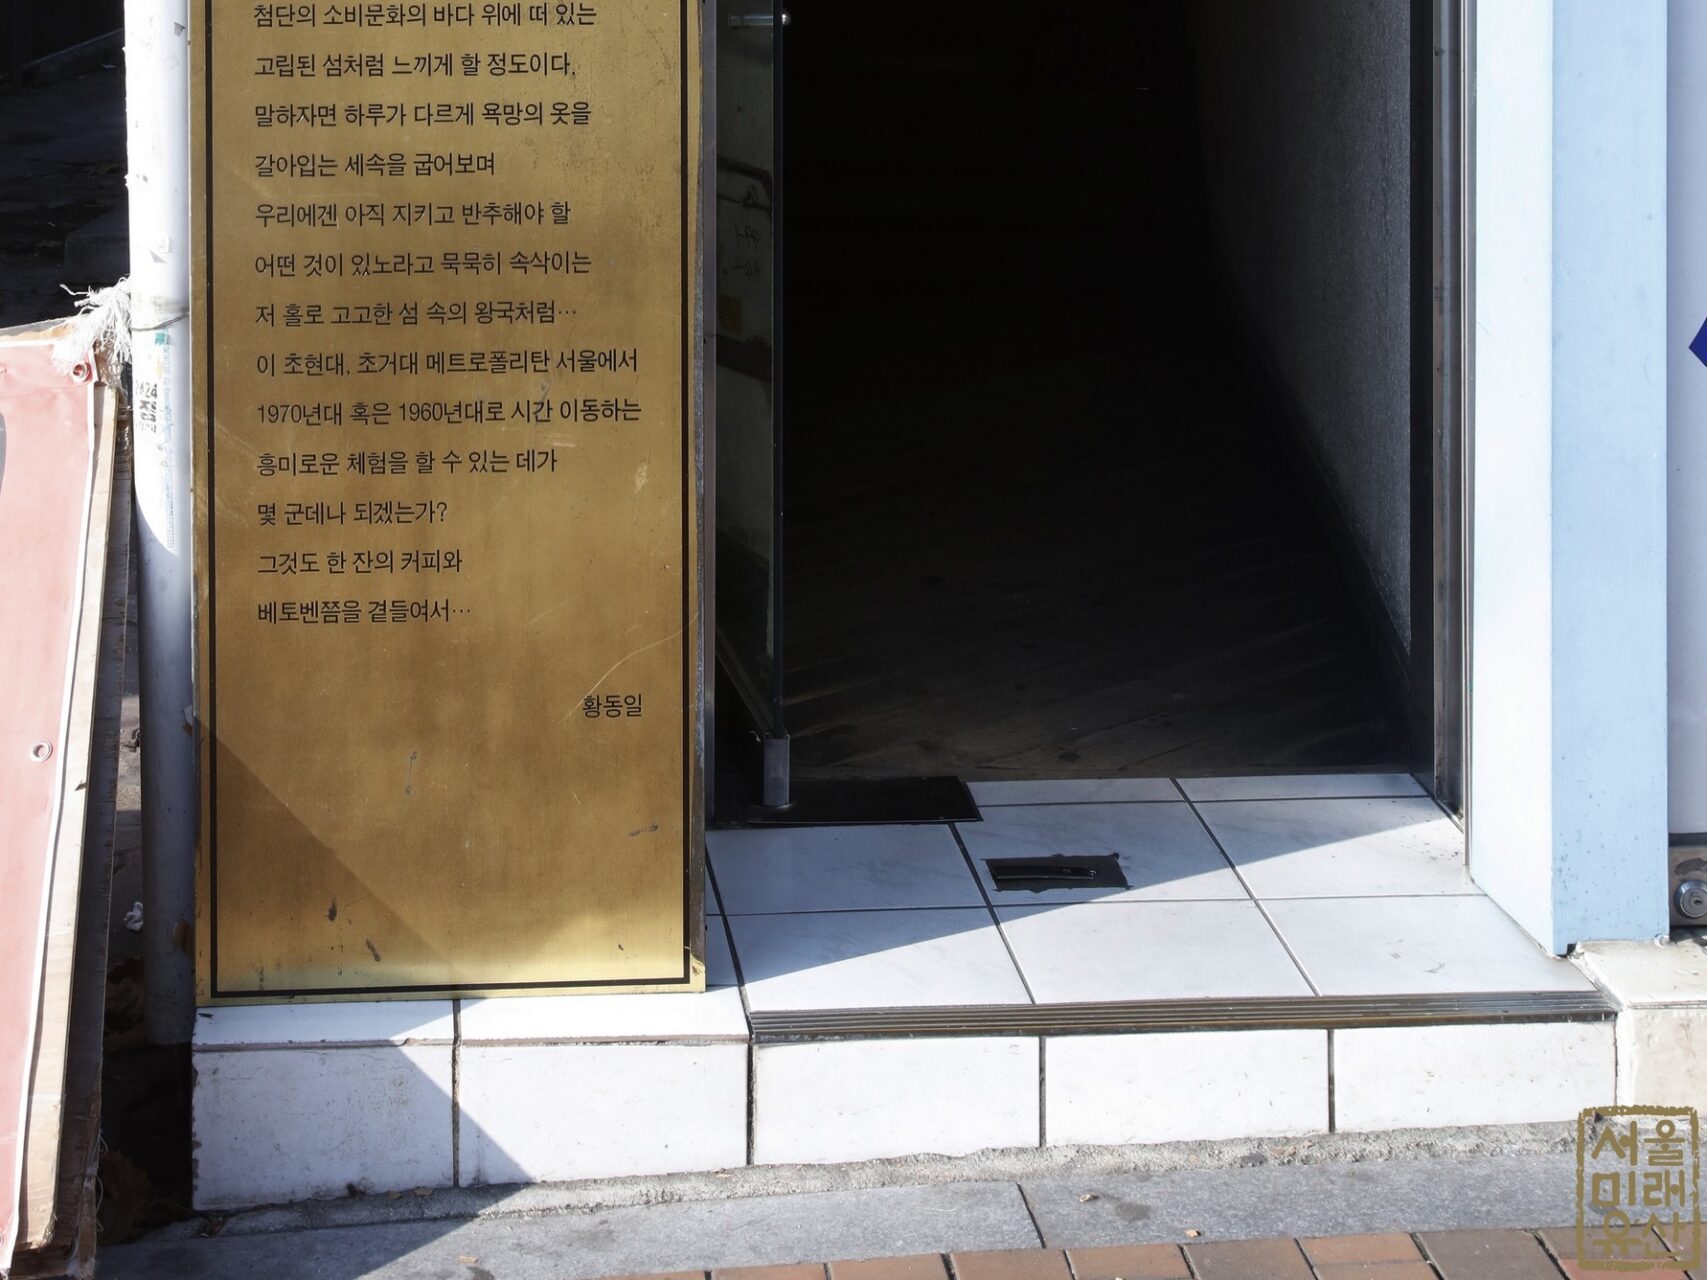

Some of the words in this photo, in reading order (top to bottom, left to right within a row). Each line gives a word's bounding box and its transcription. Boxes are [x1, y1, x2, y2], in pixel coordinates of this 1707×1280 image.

[253, 3, 316, 28] 첨단의
[322, 2, 426, 28] 소비문화의
[433, 2, 475, 27] 바다
[481, 2, 521, 27] 위에
[529, 1, 548, 27] 떠
[555, 1, 598, 26] 있는
[254, 53, 316, 78] 고립된
[322, 52, 384, 78] 섬처럼
[391, 52, 453, 78] 느끼게
[460, 52, 482, 77] 할
[487, 51, 576, 77] 정도이다.
[255, 103, 337, 128] 말하자면
[344, 103, 407, 127] 하루가
[414, 102, 474, 127] 다르게
[481, 101, 543, 127] 욕망의
[549, 101, 592, 126] 옷을
[255, 153, 339, 178] 갈아입는
[344, 152, 407, 177] 세속을
[412, 151, 495, 177] 굽어보며
[255, 203, 338, 228] 우리에겐
[345, 202, 385, 227] 아직
[392, 202, 455, 227] 지키고
[462, 201, 545, 226] 반추해야
[550, 200, 572, 225] 할
[254, 253, 296, 278] 어떤
[303, 253, 343, 277] 것이
[351, 252, 435, 276] 있노라고
[440, 251, 501, 276] 묵묵히
[509, 250, 592, 275] 속삭이는
[255, 303, 275, 328] 저
[283, 303, 325, 327] 홀로
[330, 302, 393, 326] 고고한
[398, 301, 418, 326] 섬
[426, 301, 467, 325] 속의
[256, 353, 275, 377] 이
[283, 352, 350, 377] 초현대,
[357, 351, 418, 376] 초거대
[426, 349, 551, 375] 메트로폴리탄
[555, 348, 637, 373] 서울에서
[257, 402, 342, 427] 1970년대
[350, 402, 392, 426] 혹은
[399, 399, 506, 424] 1960년대로
[510, 399, 554, 424] 시간
[559, 397, 642, 423] 이동하는
[256, 452, 340, 477] 흥미로운
[346, 451, 409, 476] 체험을
[415, 450, 436, 474] 할
[441, 449, 463, 474] 수
[468, 449, 510, 473] 있는
[516, 448, 558, 473] 데가
[257, 502, 276, 526] 몇
[284, 501, 347, 526] 군데나
[353, 500, 448, 525] 되겠는가?
[257, 551, 320, 576] 그것도
[326, 550, 347, 574] 한
[352, 549, 394, 574] 잔의
[400, 548, 463, 574] 커피와
[258, 600, 362, 625] 베토벤쯤을
[582, 693, 642, 719] 황동일
